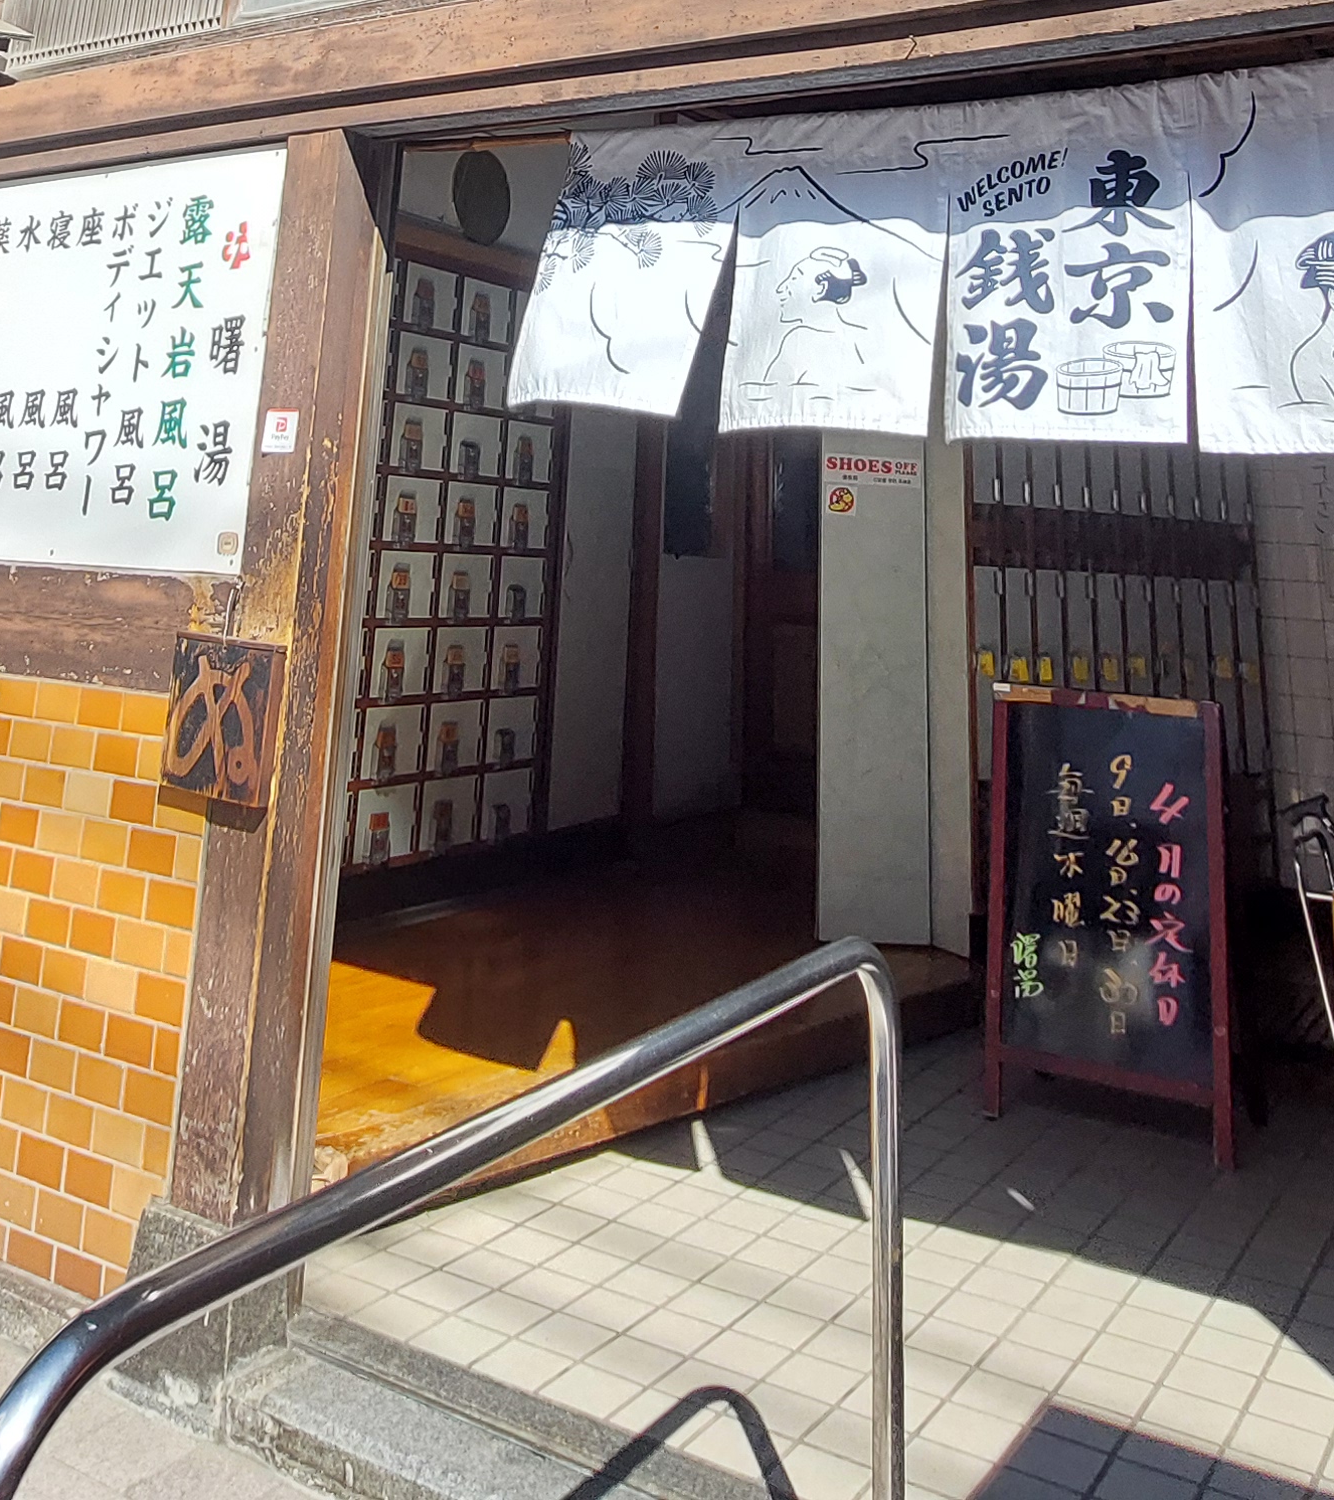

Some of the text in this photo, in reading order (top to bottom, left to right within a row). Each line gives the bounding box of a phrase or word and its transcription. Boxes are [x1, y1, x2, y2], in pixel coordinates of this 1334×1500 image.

[957, 148, 1068, 212] WELCOME!
[983, 176, 1051, 217] SENTO
[1062, 150, 1175, 329] 東京
[13, 210, 74, 490] 寝風呂
[44, 207, 106, 490] 座風呂
[147, 195, 214, 521] 露天岩風呂
[194, 314, 246, 487] 曙湯
[955, 228, 1055, 410] 銭湯
[826, 456, 917, 474] SHOES OFF
[1144, 782, 1193, 1026] 4月の定休日
